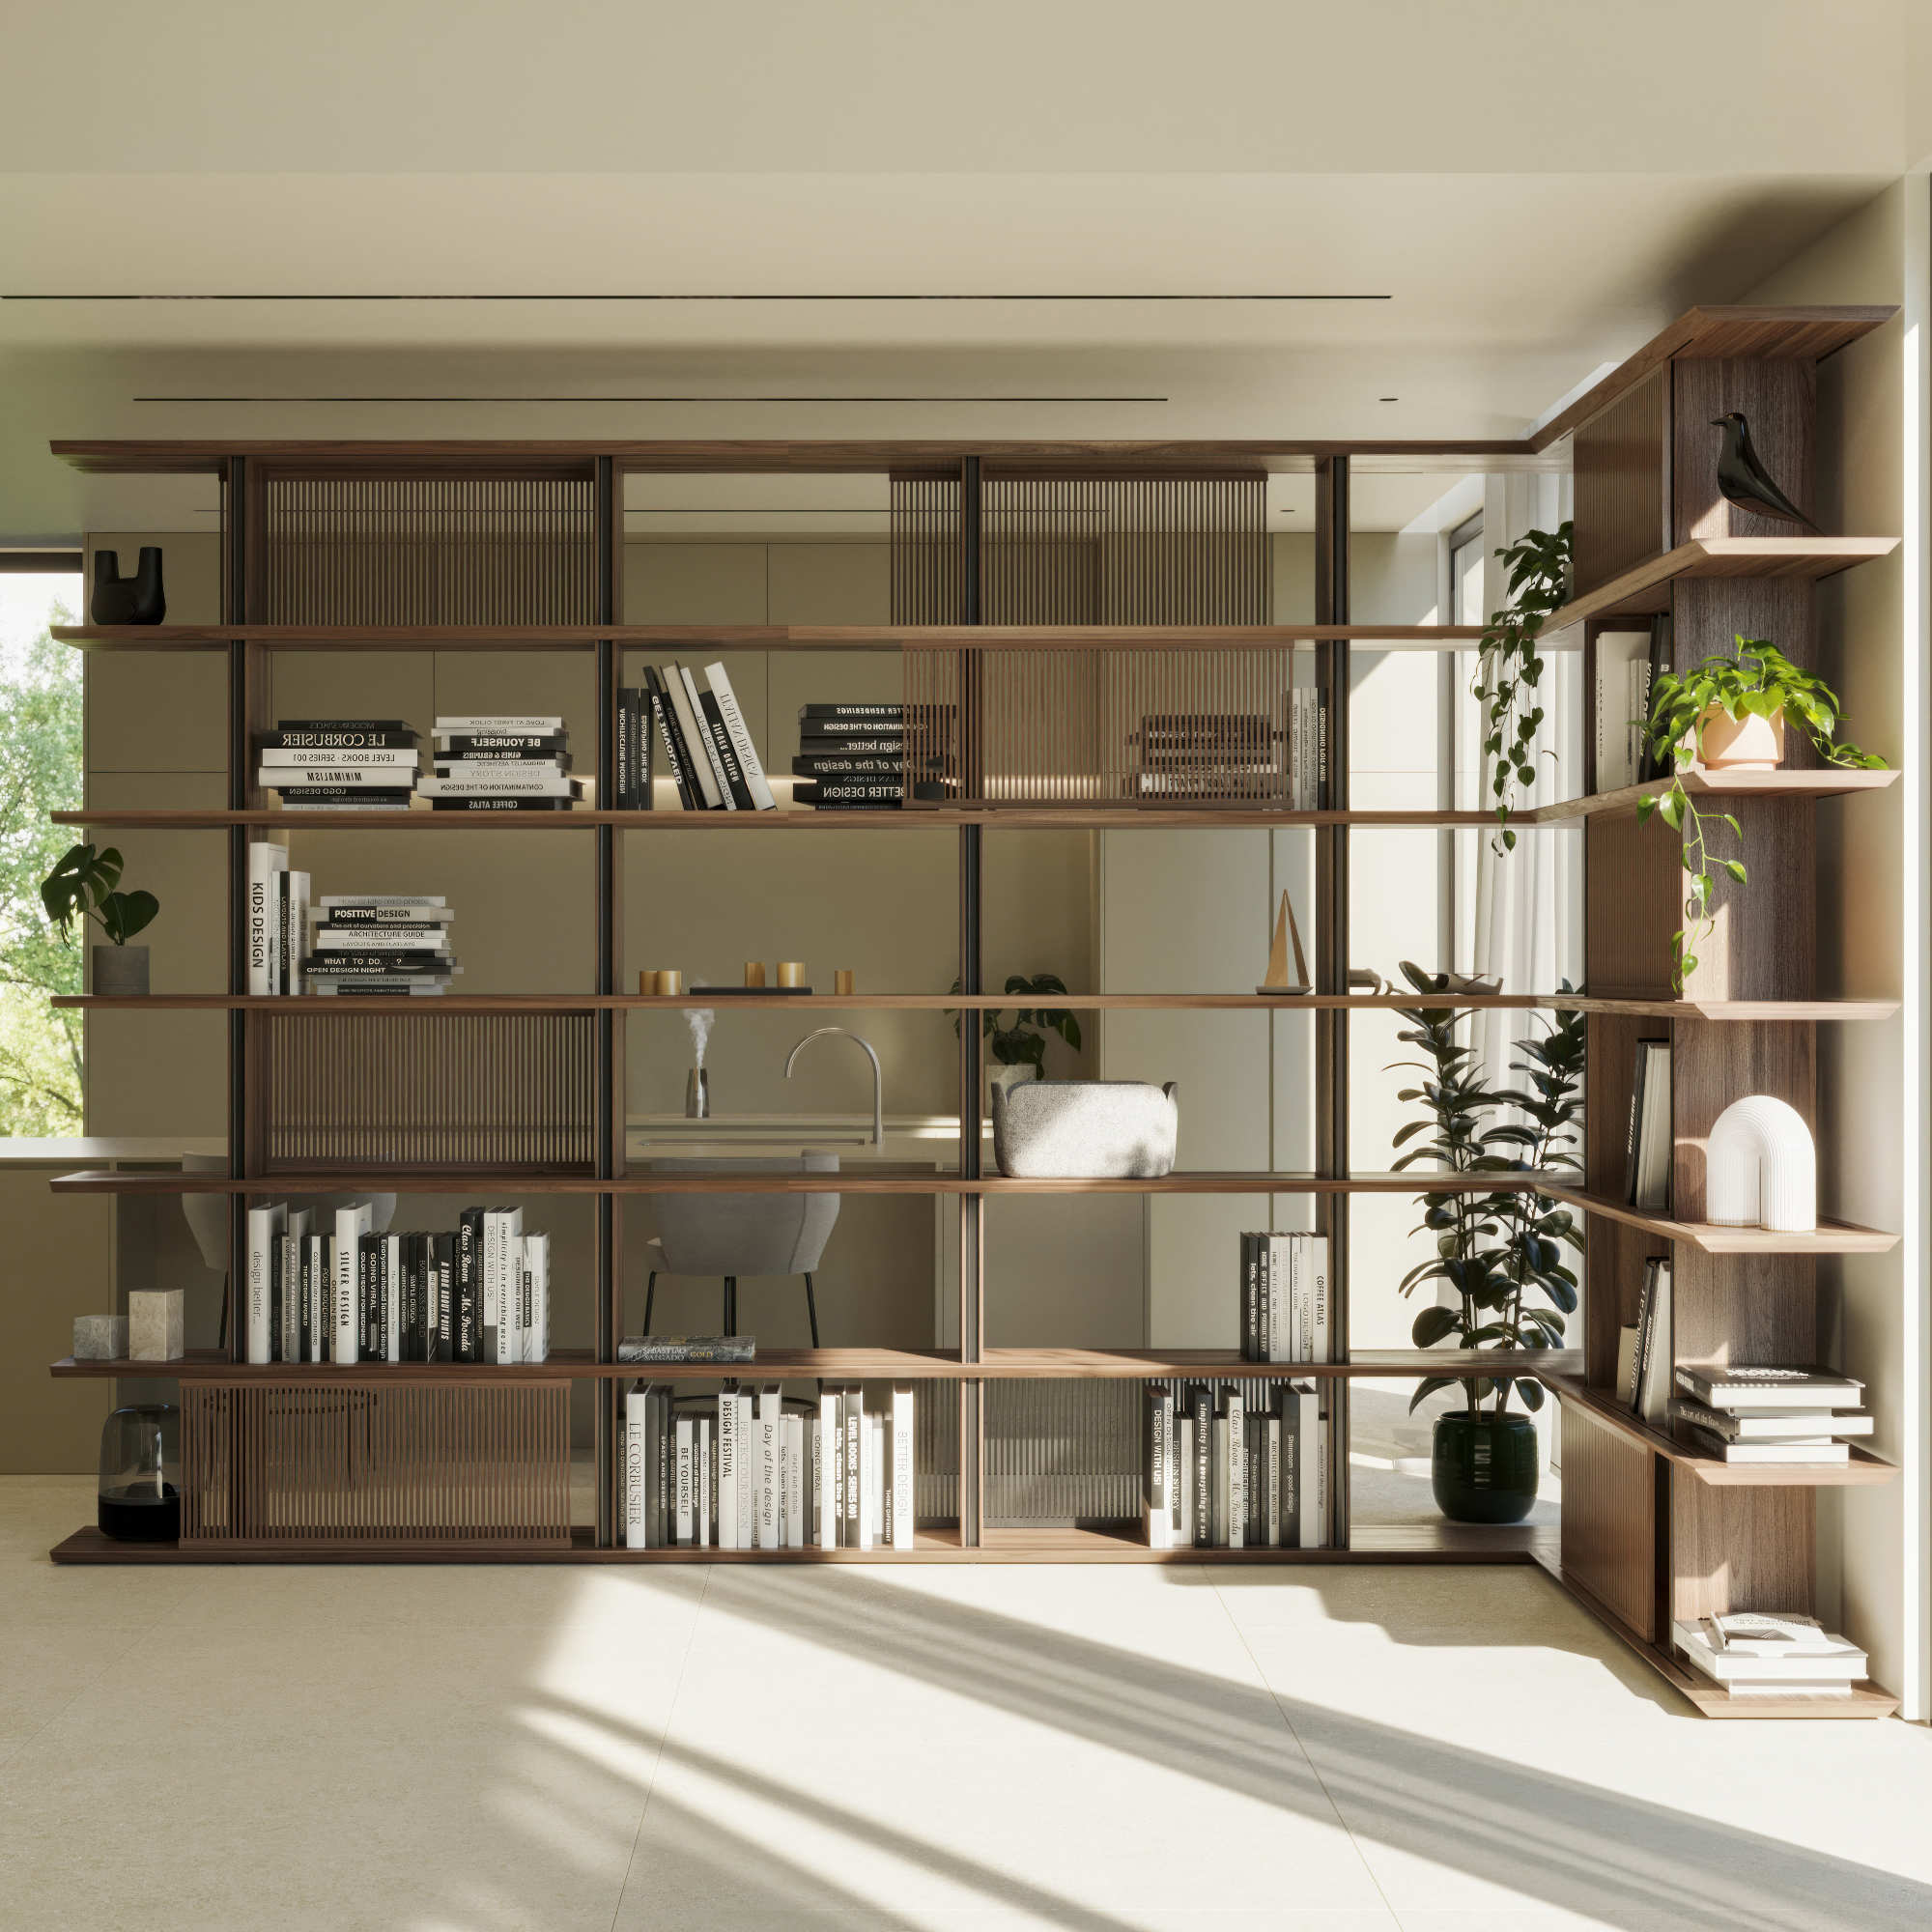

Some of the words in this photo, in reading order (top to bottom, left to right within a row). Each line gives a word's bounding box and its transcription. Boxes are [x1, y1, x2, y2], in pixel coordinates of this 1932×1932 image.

[252, 882, 264, 914] KIDS
[252, 918, 264, 968] DESIGN
[461, 1224, 472, 1251] Class
[251, 1251, 263, 1284] design
[340, 1251, 350, 1285] SILVER
[440, 1269, 449, 1288] BOOK
[461, 1253, 472, 1283] Room
[440, 1290, 449, 1312] ABOUT
[1316, 1275, 1324, 1301] COFFEE
[340, 1291, 350, 1327] DESIGN
[461, 1294, 472, 1314] Ms.
[1316, 1303, 1324, 1325] ATLAS
[440, 1314, 449, 1341] POINTS
[461, 1316, 472, 1352] Posada
[500, 1328, 506, 1339] we
[379, 1333, 387, 1359] design
[629, 1422, 641, 1440] LE
[723, 1401, 732, 1435] DESIGN
[847, 1416, 858, 1441] LEVEL
[1153, 1409, 1162, 1443] DESIGN
[1232, 1408, 1242, 1432] Class
[762, 1424, 773, 1445] Day
[680, 1447, 689, 1461] BE
[723, 1438, 732, 1478] FESTIVAL
[764, 1450, 773, 1461] of
[847, 1442, 858, 1470] BOOKS
[896, 1431, 908, 1471] BETTER
[1153, 1445, 1162, 1468] WITH
[1200, 1456, 1207, 1464] in
[1232, 1438, 1242, 1467] Room
[629, 1443, 641, 1525] CORBUSIER
[764, 1464, 773, 1485] the
[1153, 1469, 1162, 1485] US!
[680, 1463, 689, 1517] YOURSELF
[847, 1475, 858, 1503] SERIES
[896, 1474, 908, 1517] DESIGN
[1232, 1481, 1242, 1496] Ms.
[762, 1487, 773, 1526] design
[847, 1503, 858, 1519] 001
[1200, 1512, 1206, 1521] we
[1232, 1500, 1242, 1535] Posada
